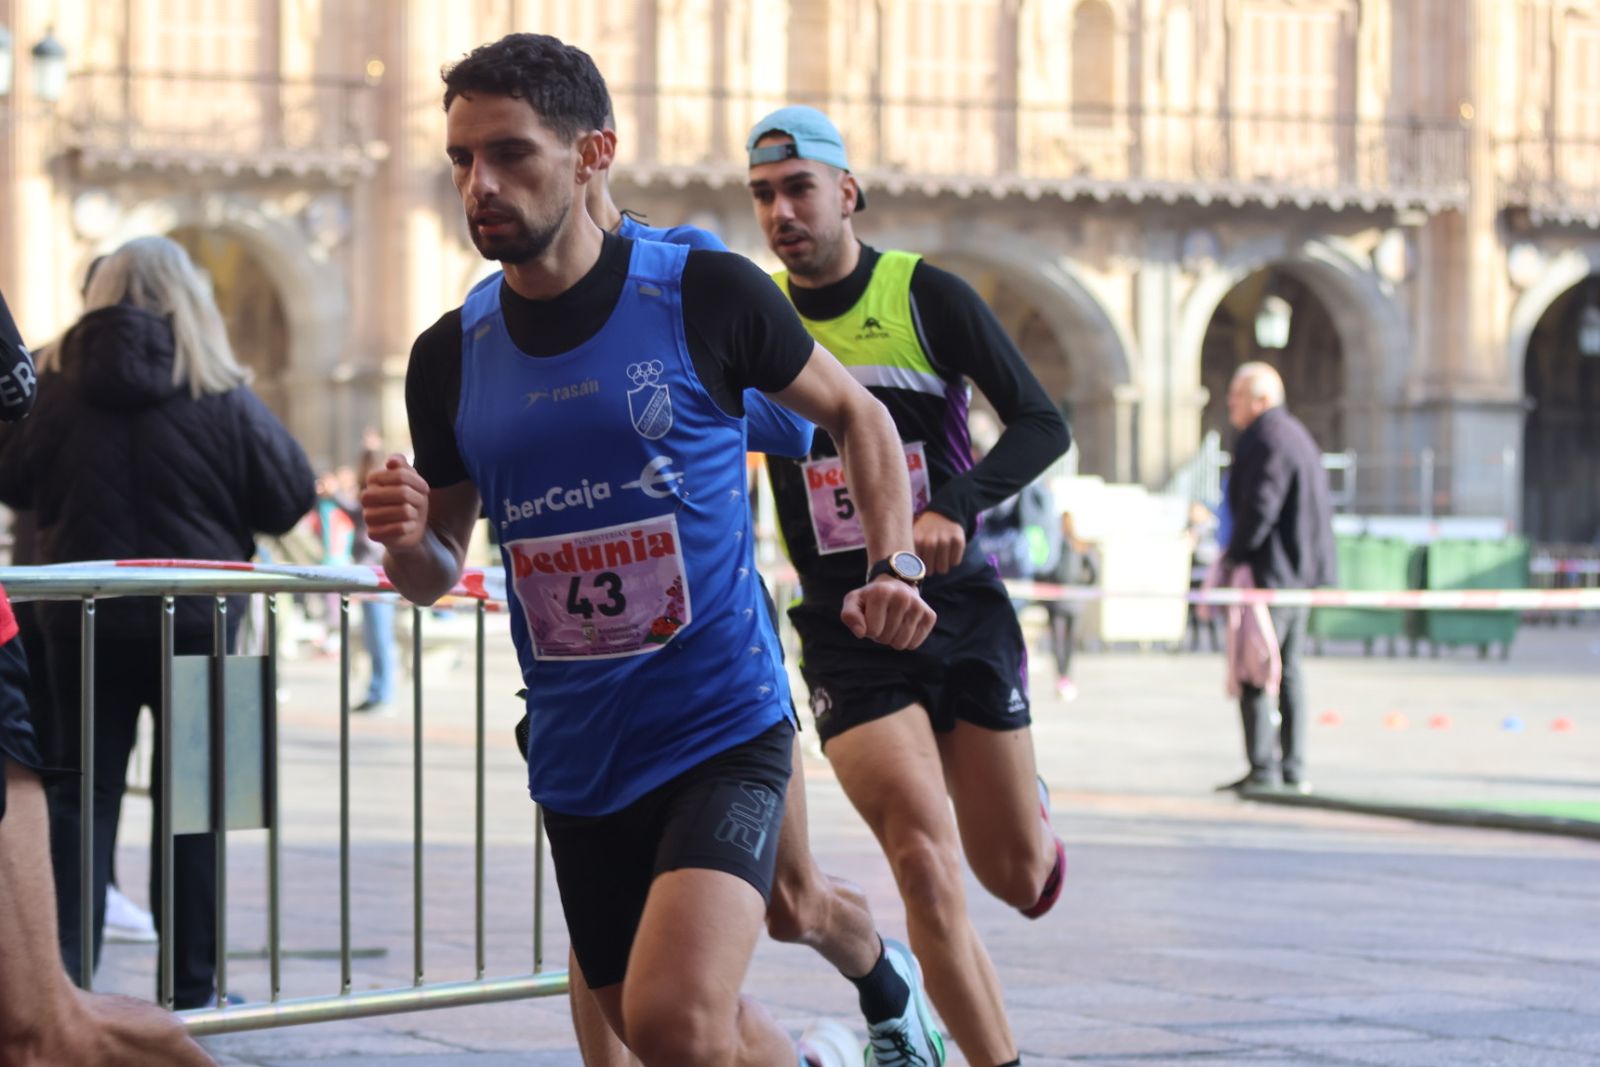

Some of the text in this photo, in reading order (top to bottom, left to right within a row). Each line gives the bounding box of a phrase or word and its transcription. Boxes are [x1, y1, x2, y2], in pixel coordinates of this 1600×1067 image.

[552, 377, 599, 402] rasán
[511, 529, 675, 578] bedunia
[566, 571, 626, 619] 43
